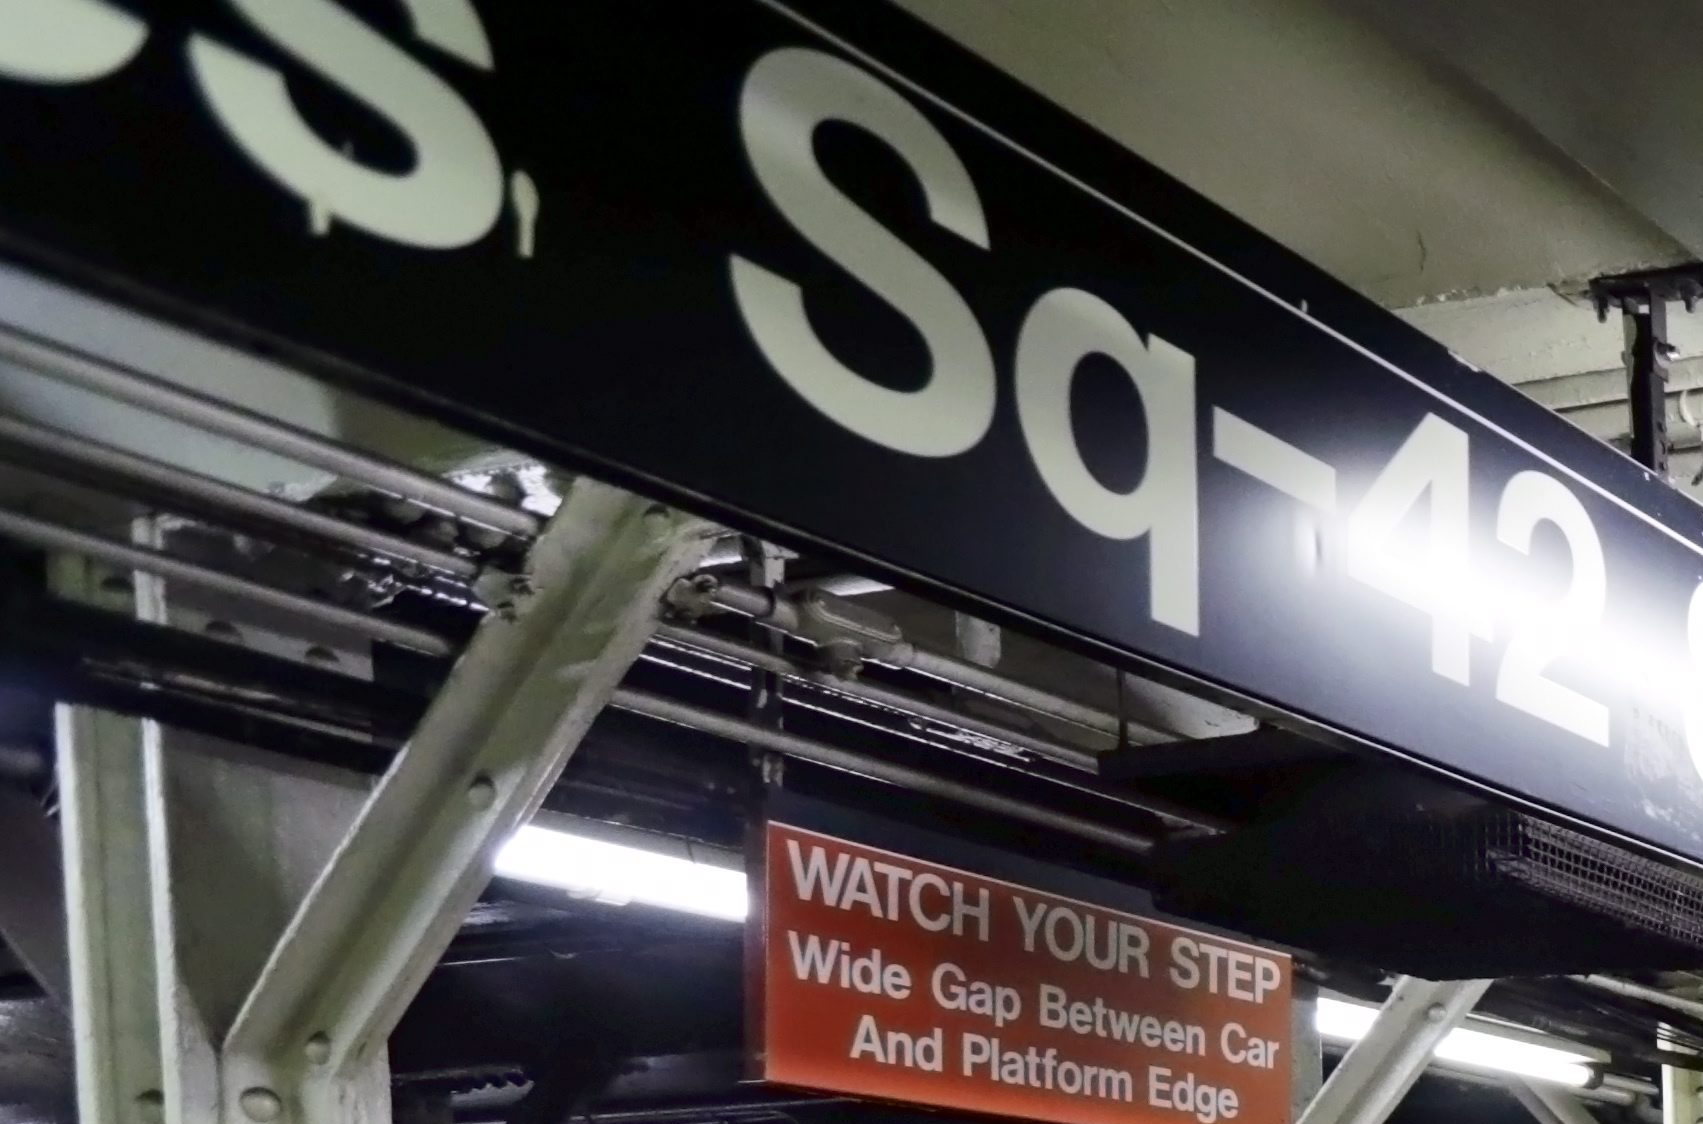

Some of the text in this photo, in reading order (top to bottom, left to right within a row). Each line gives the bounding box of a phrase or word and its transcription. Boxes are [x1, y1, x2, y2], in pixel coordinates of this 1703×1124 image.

[786, 839, 1281, 1004] WATCH YOUR STEP
[787, 930, 1280, 1070] Wide Gap Between Car
[850, 1014, 1239, 1124] And Platform Edge
